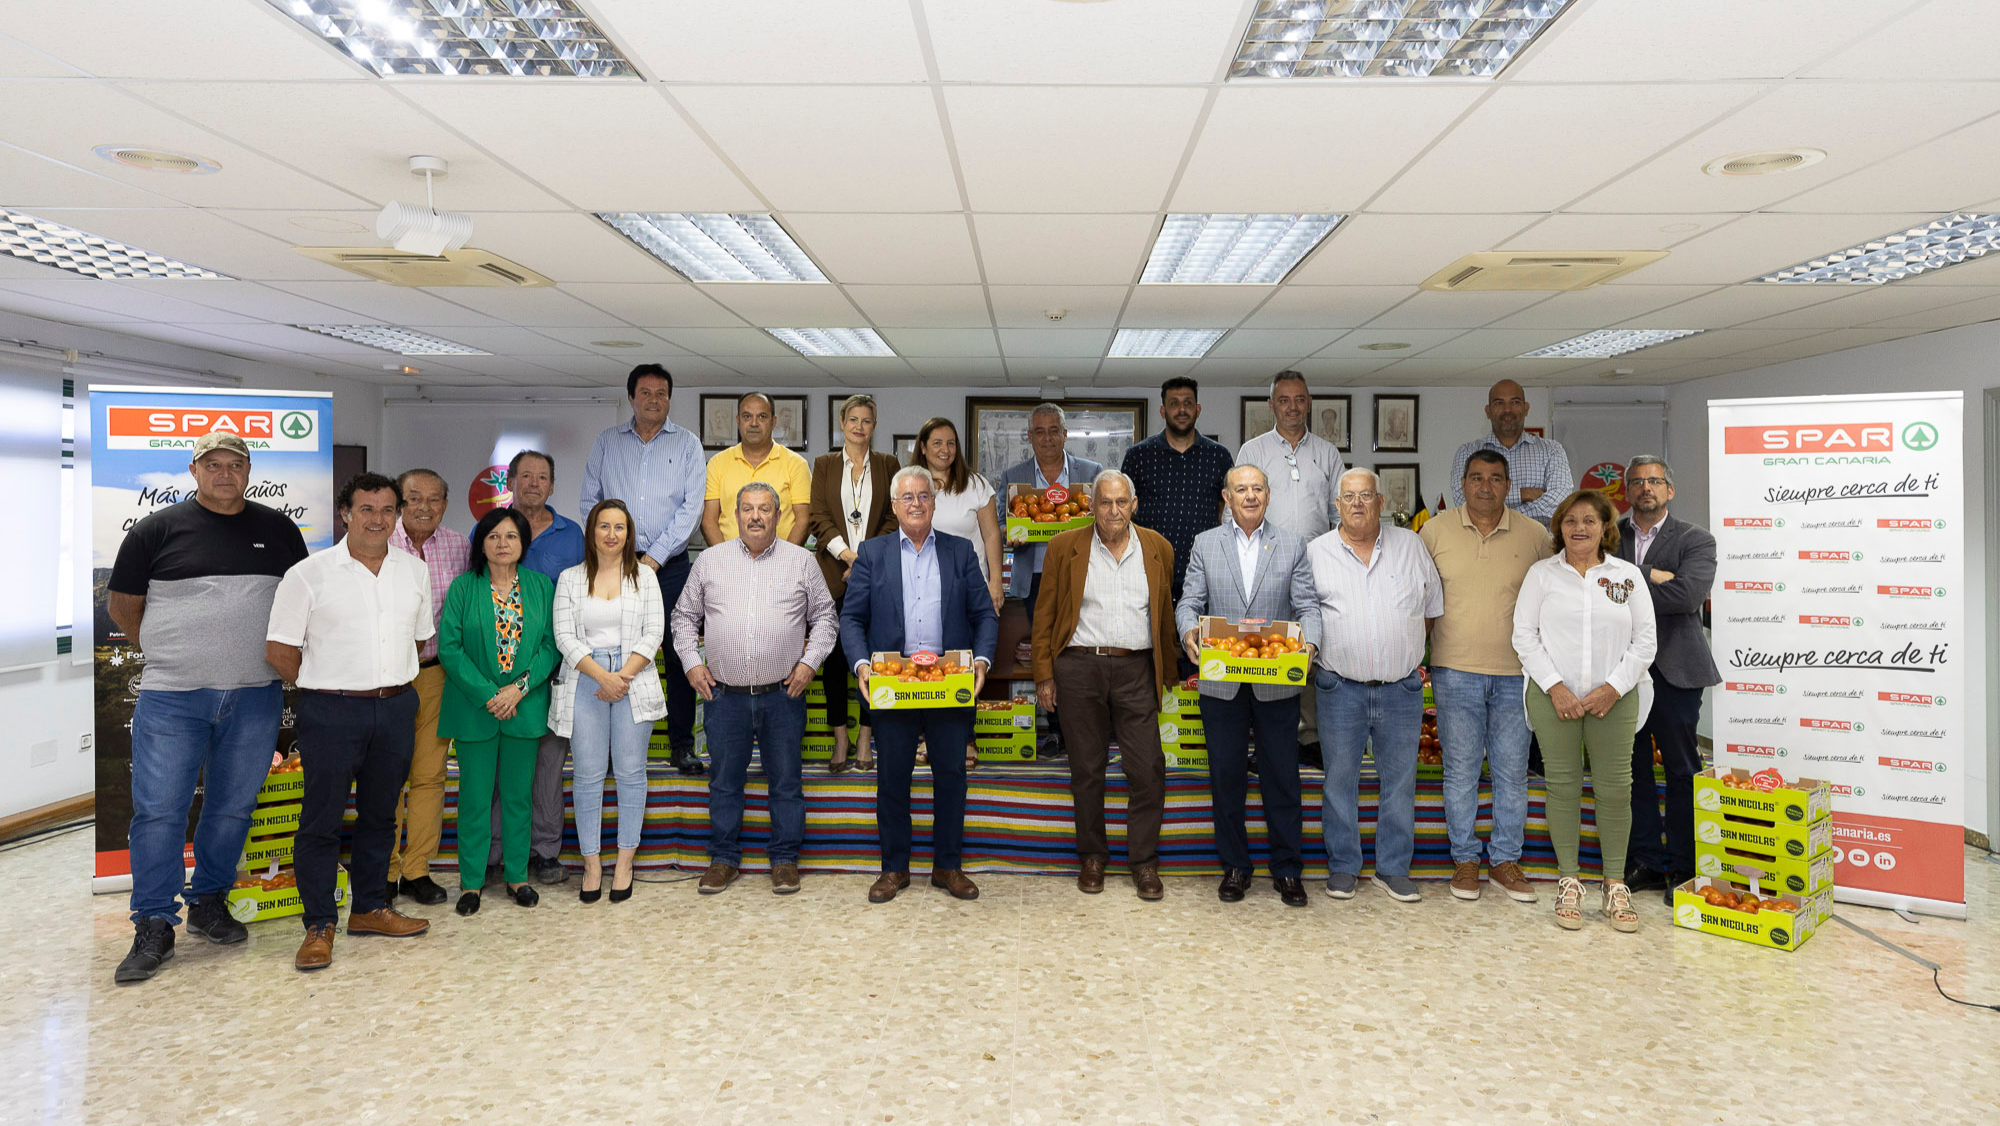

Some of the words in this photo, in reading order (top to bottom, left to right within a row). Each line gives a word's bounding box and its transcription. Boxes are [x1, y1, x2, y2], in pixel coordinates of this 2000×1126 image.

[148, 413, 271, 434] SPAR
[1762, 427, 1890, 449] SPAR
[1814, 456, 1891, 465] CANARIA
[244, 480, 288, 499] años
[1840, 482, 1889, 497] cerca
[1894, 473, 1919, 493] de
[138, 485, 180, 507] Más
[1734, 518, 1772, 526] SPAR
[1889, 519, 1931, 528] SPAR
[1734, 582, 1773, 590] SPAR
[1889, 587, 1931, 596] SPAR
[1810, 616, 1850, 625] SPAR
[1823, 649, 1884, 666] cerca
[1890, 641, 1924, 665] de
[1928, 643, 1949, 665] ti
[1225, 665, 1242, 675] SAN
[1242, 665, 1278, 676] NICOLAS
[1736, 683, 1774, 692] SPAR
[894, 691, 911, 700] SAN
[912, 690, 946, 700] NICOLAS
[1889, 693, 1932, 703] SPAR
[1811, 720, 1851, 730] SPAR
[1737, 745, 1775, 756] SPAR
[1890, 759, 1932, 770] SPAR
[267, 780, 304, 793] NICOLAS
[1831, 786, 1851, 794] AR
[1930, 794, 1939, 802] de
[1719, 795, 1737, 807] SAN
[1738, 798, 1775, 813] NICOLAS
[251, 817, 265, 828] AN
[1720, 829, 1738, 840] SAN
[1739, 832, 1776, 847] NICOLAS
[245, 850, 264, 862] SAN
[256, 899, 275, 912] SAN
[1700, 913, 1719, 926] SAN
[1719, 917, 1759, 935] NICOLAS
